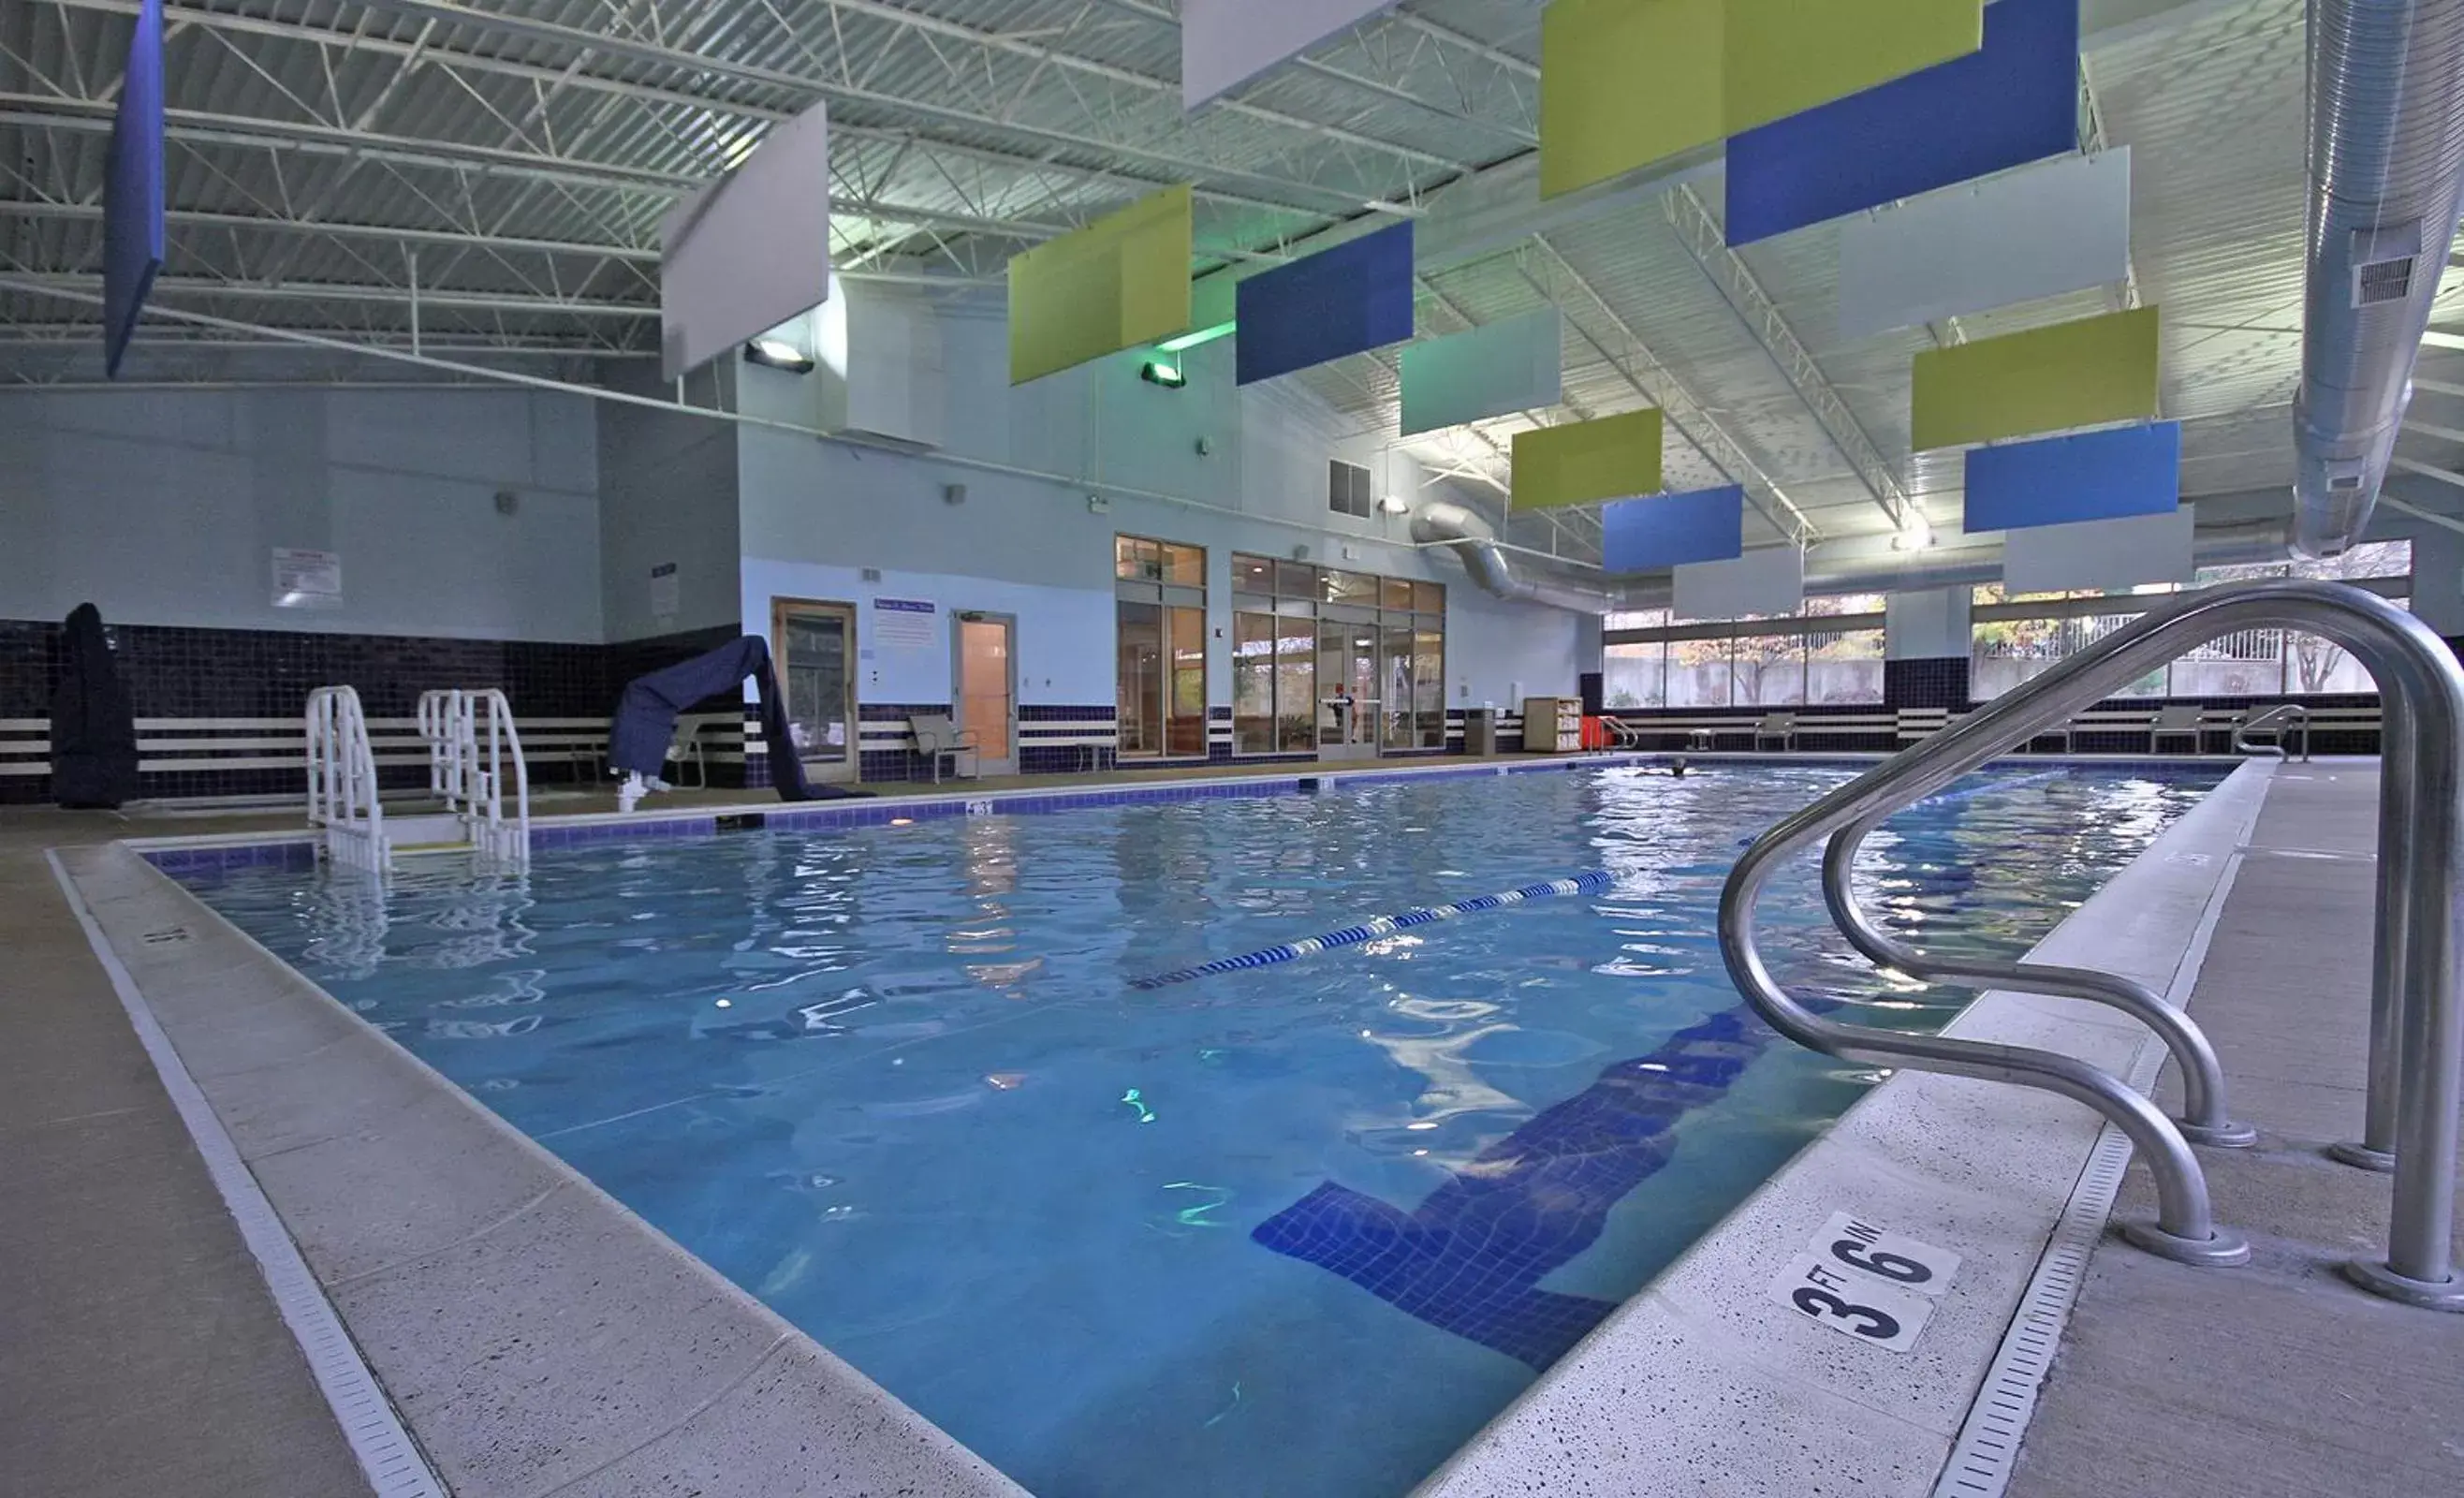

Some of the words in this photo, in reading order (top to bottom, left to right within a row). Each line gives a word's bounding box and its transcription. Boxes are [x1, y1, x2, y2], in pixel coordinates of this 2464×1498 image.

[1842, 1219, 1884, 1245] IN
[1805, 1263, 1848, 1293] FT
[1830, 1239, 1933, 1284] 6
[1792, 1286, 1900, 1339] 3
